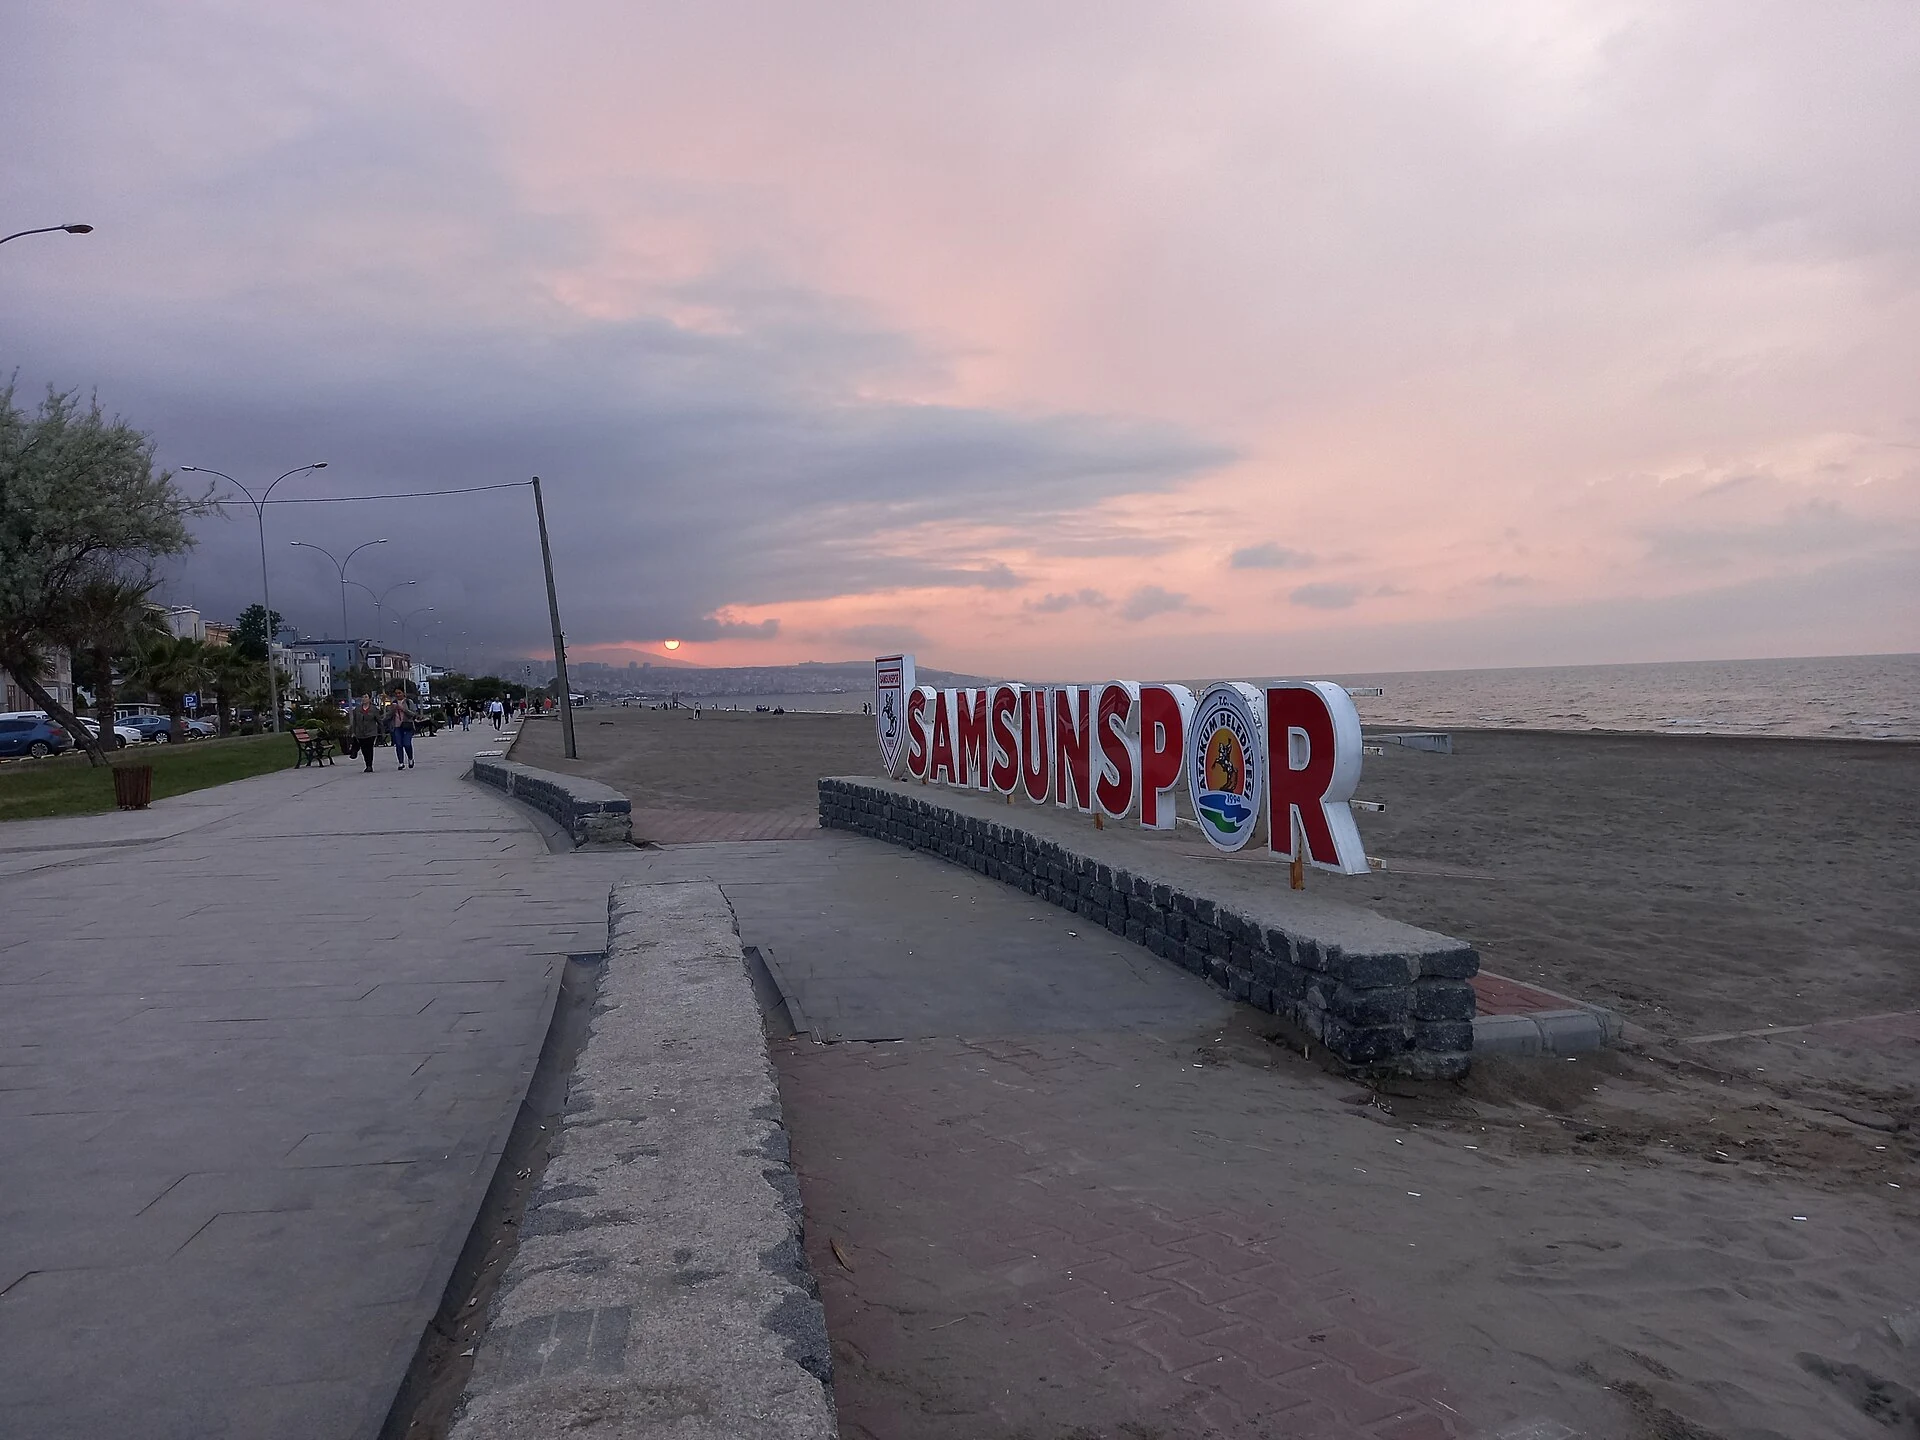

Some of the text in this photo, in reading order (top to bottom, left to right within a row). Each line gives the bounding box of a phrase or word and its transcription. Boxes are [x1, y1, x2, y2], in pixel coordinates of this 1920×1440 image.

[1218, 696, 1229, 706] T.C.
[1199, 718, 1218, 790] ATAKUM
[1226, 793, 1241, 804] 1994
